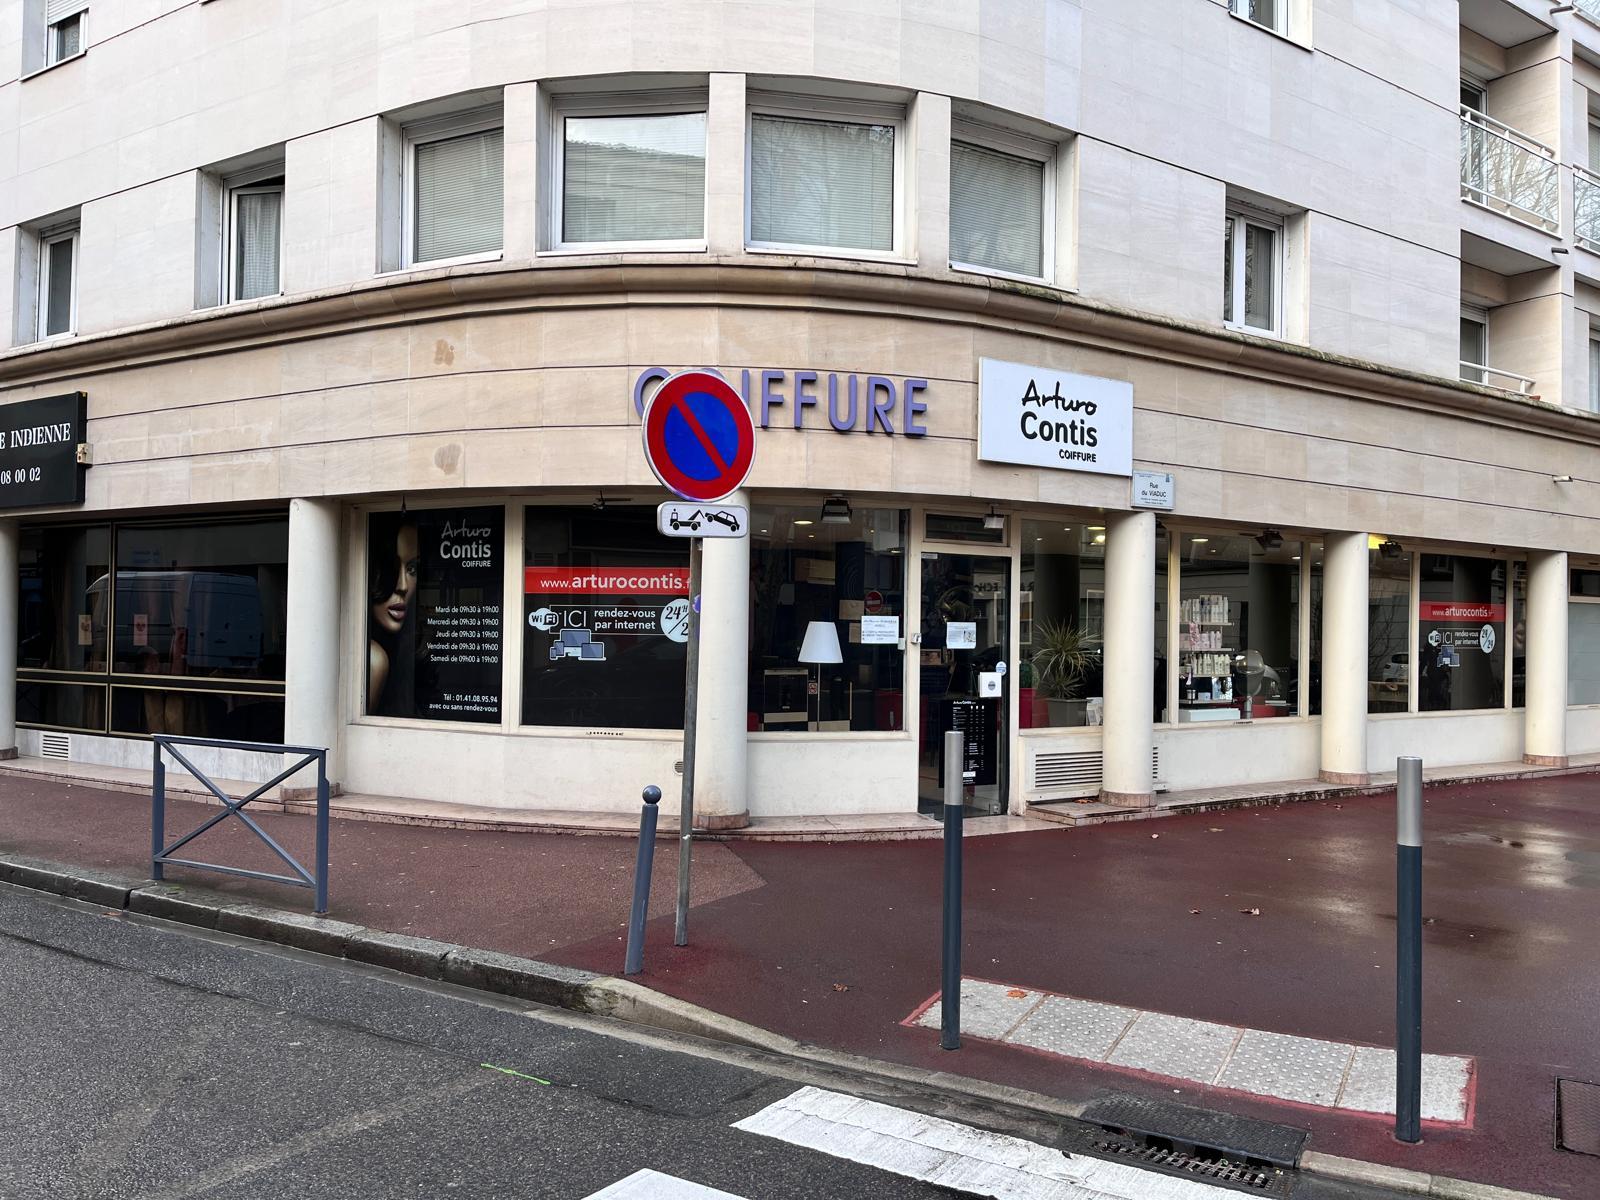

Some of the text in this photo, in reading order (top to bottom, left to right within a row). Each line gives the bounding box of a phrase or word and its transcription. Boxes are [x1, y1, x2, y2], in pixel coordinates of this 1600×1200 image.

[633, 367, 928, 438] CIFFURE
[1021, 379, 1098, 416] Arturo
[1020, 411, 1098, 447] Contis
[10, 422, 71, 448] INDIENNE
[1058, 448, 1097, 463] COIFFURE
[0, 466, 41, 485] 08 00 02
[1149, 490, 1167, 498] VIADUC
[440, 518, 492, 539] Arturo
[440, 540, 492, 559] Contis
[461, 560, 492, 568] COIFFURE
[594, 608, 656, 618] rendez-vous
[451, 618, 459, 626] de
[459, 618, 477, 626] 09h30
[482, 618, 499, 626] 19h00
[563, 610, 588, 628] ICI
[594, 620, 656, 631] par internet
[459, 630, 477, 638] 09h30
[1442, 632, 1453, 644] ICI
[426, 642, 450, 650] Vendredi
[458, 642, 476, 650] 09h30
[481, 643, 499, 651] 19h00
[430, 654, 450, 662] Samedi
[458, 655, 476, 663] 09h00
[455, 694, 498, 703] 01.41.08.95.94
[463, 704, 498, 713] rendez-vous
